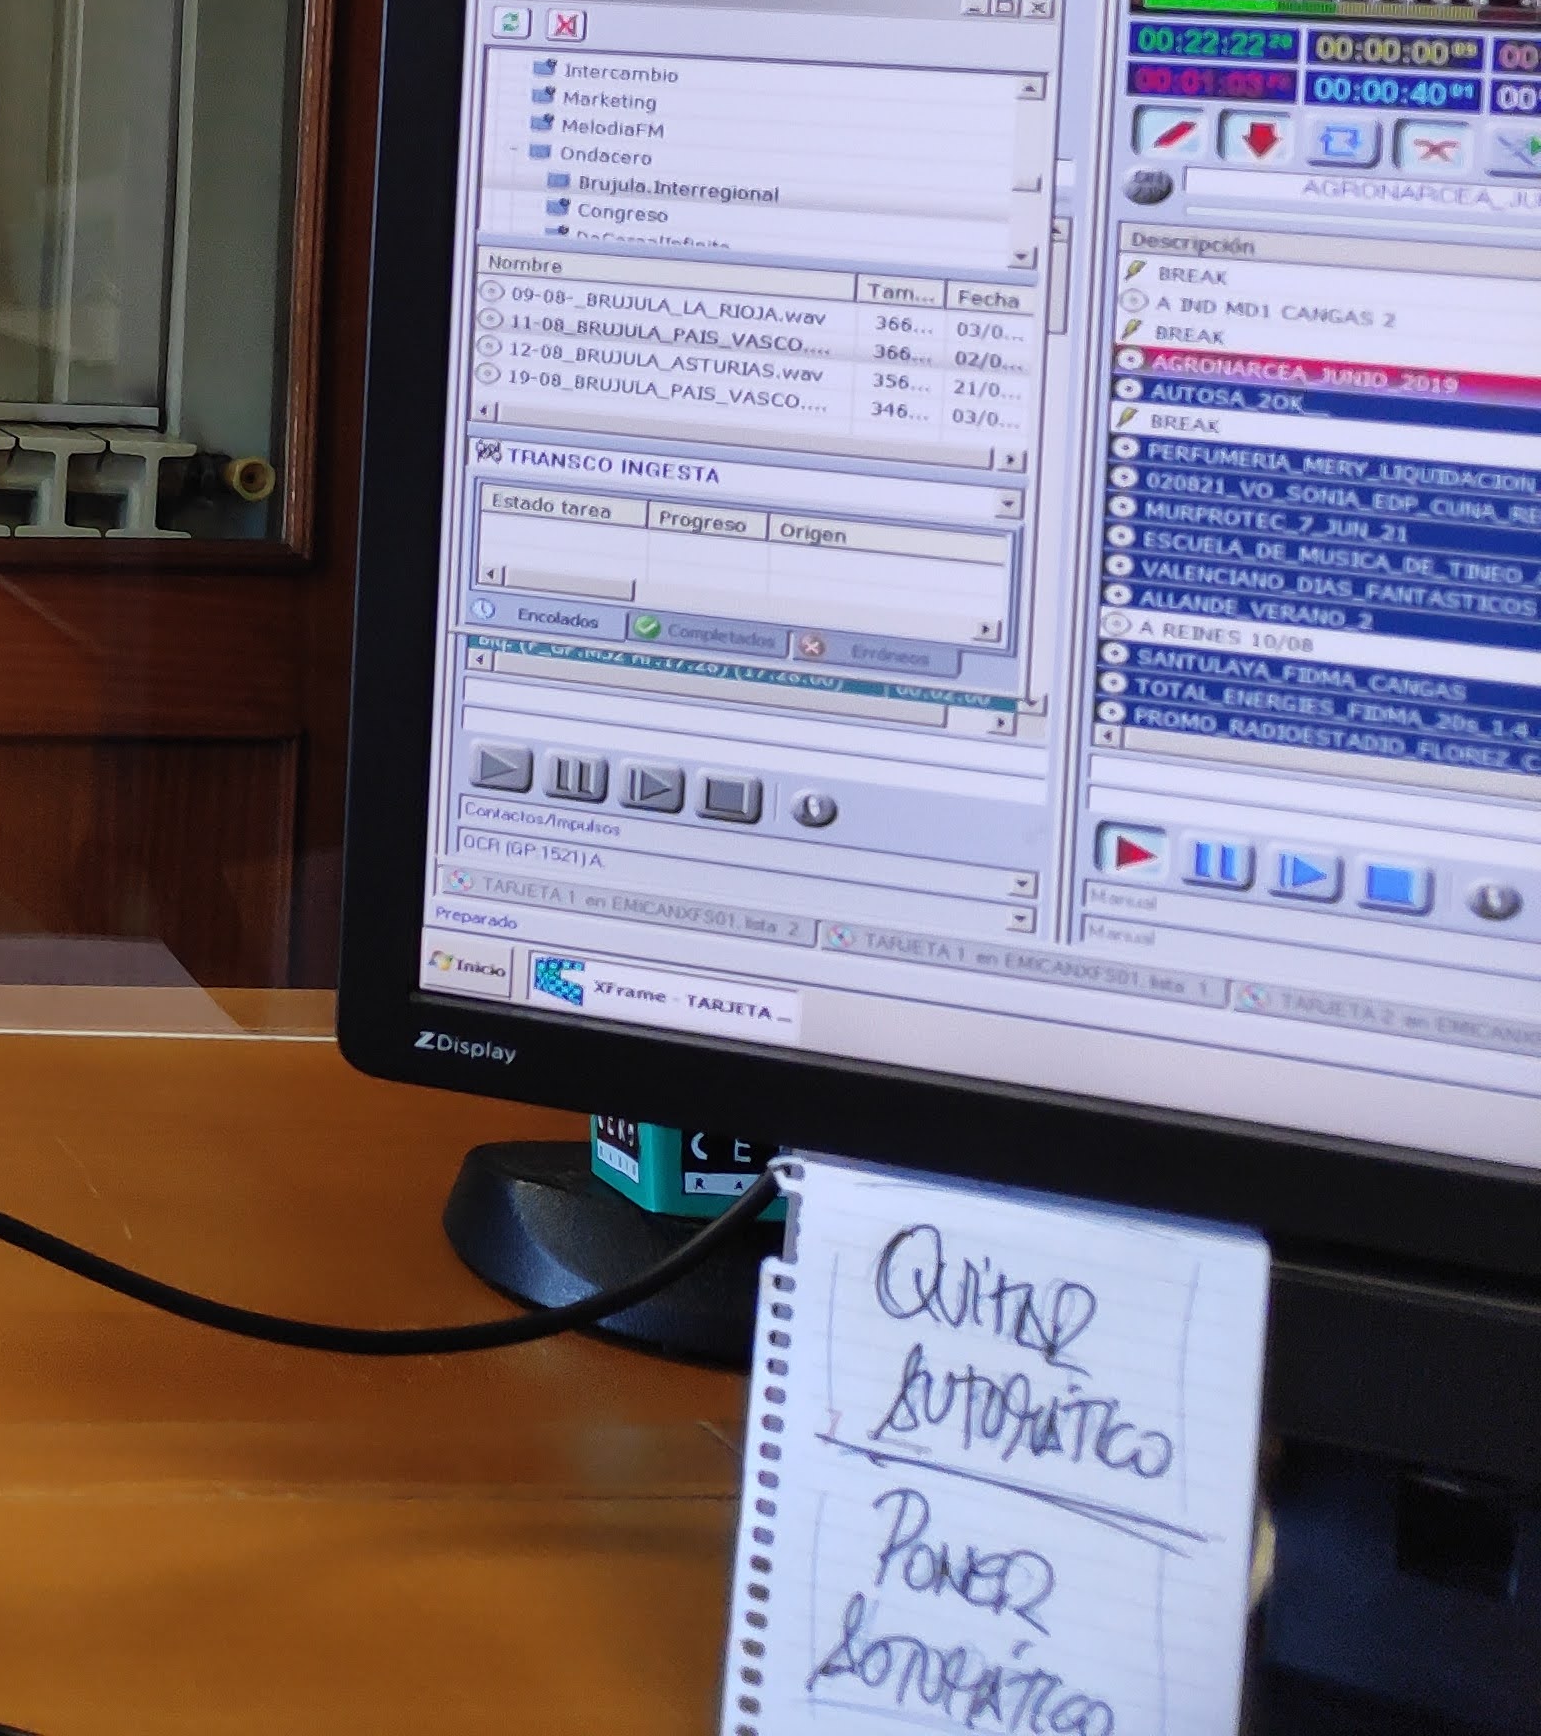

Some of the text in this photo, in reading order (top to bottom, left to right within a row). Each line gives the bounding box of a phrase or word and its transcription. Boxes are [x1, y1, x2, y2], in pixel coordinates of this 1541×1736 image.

[564, 64, 679, 84] Intercambio
[563, 91, 658, 113] Marketing
[561, 118, 665, 139] MelodiaFM
[560, 146, 652, 166] Ondacero
[578, 175, 780, 204] Brujula.Interregional
[577, 203, 669, 225] Congreso
[1131, 232, 1256, 257] Descripción
[488, 257, 563, 275] Nombre
[958, 290, 1020, 309] Fecha
[1158, 266, 1228, 286] BREAK
[1156, 297, 1171, 312] A
[1282, 306, 1374, 327] CANGAS
[1384, 313, 1396, 328] 2
[1155, 325, 1225, 345] BREAK
[1150, 414, 1220, 434] BREAK
[509, 448, 720, 484] TRANSCO INGESTA
[492, 492, 847, 547] Estado tarea Progreso Origen
[518, 607, 599, 631] Encolados
[668, 622, 776, 650] Completados
[1140, 621, 1314, 653] A REINES 10/08
[465, 802, 620, 836] Contactos/Impulsos
[435, 904, 518, 931] Preparado
[456, 956, 507, 980] Inicio
[686, 995, 773, 1020] TARJETA
